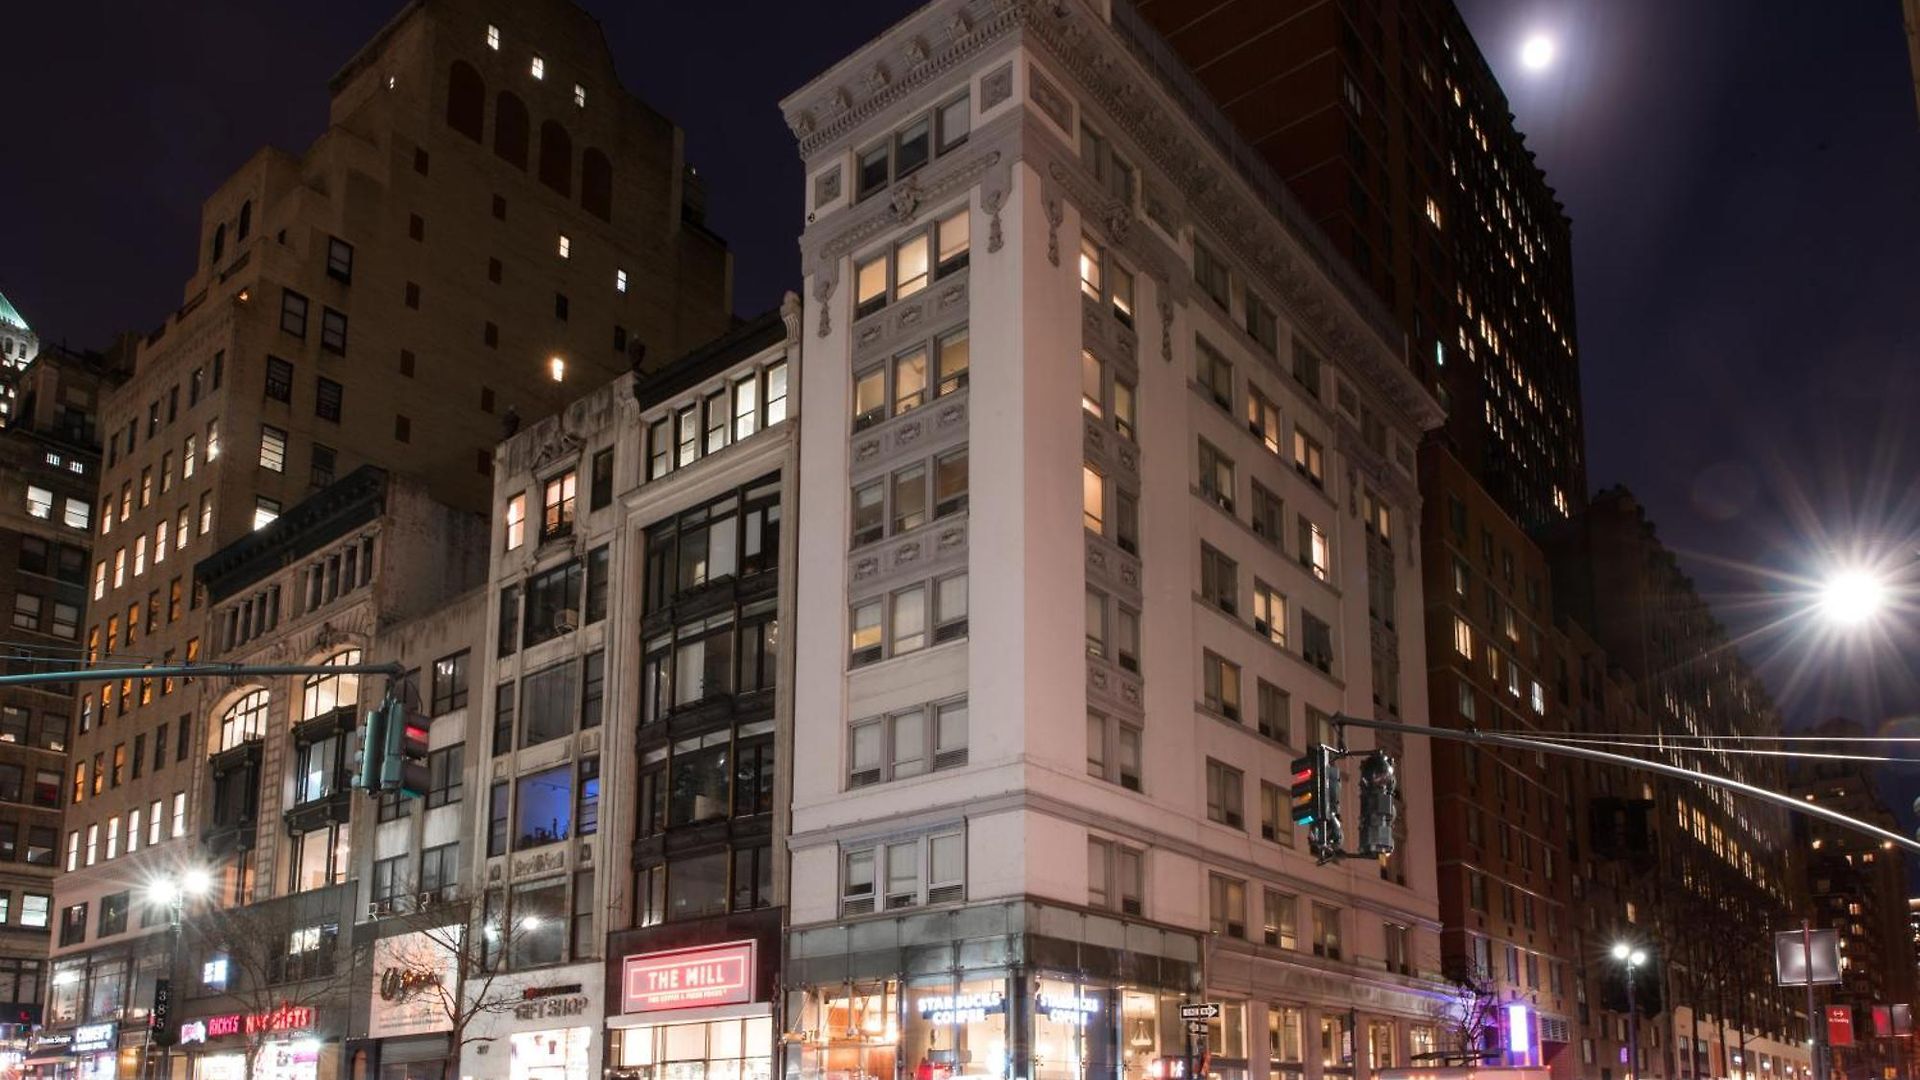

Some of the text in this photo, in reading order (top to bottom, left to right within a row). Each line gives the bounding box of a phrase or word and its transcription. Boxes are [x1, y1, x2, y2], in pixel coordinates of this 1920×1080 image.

[648, 964, 725, 991] THE MILL
[156, 991, 168, 1029] 385
